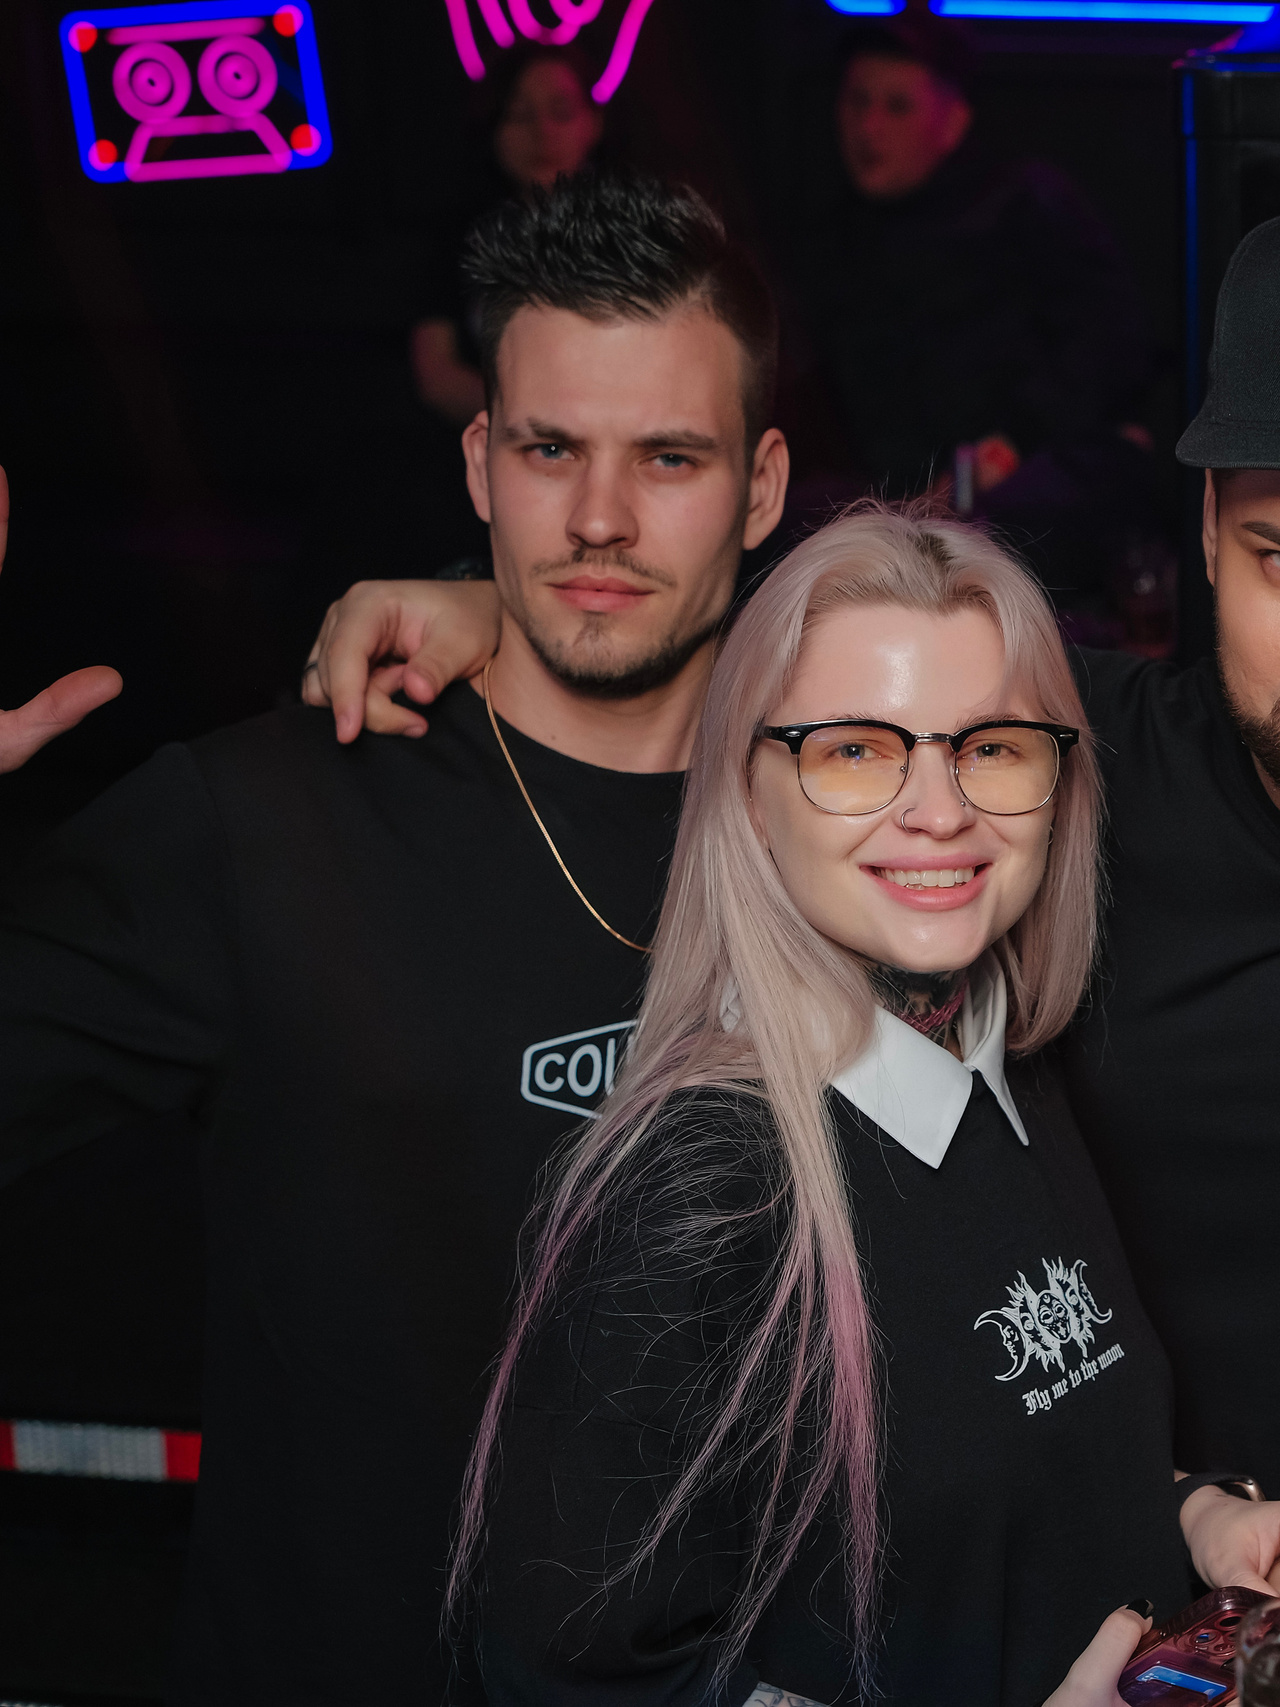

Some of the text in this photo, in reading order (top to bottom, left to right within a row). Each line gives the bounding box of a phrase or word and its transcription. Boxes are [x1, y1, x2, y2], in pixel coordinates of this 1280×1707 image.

[1051, 1377, 1069, 1400] me
[1068, 1369, 1083, 1389] to
[1080, 1358, 1100, 1382] the
[1096, 1342, 1126, 1371] moon
